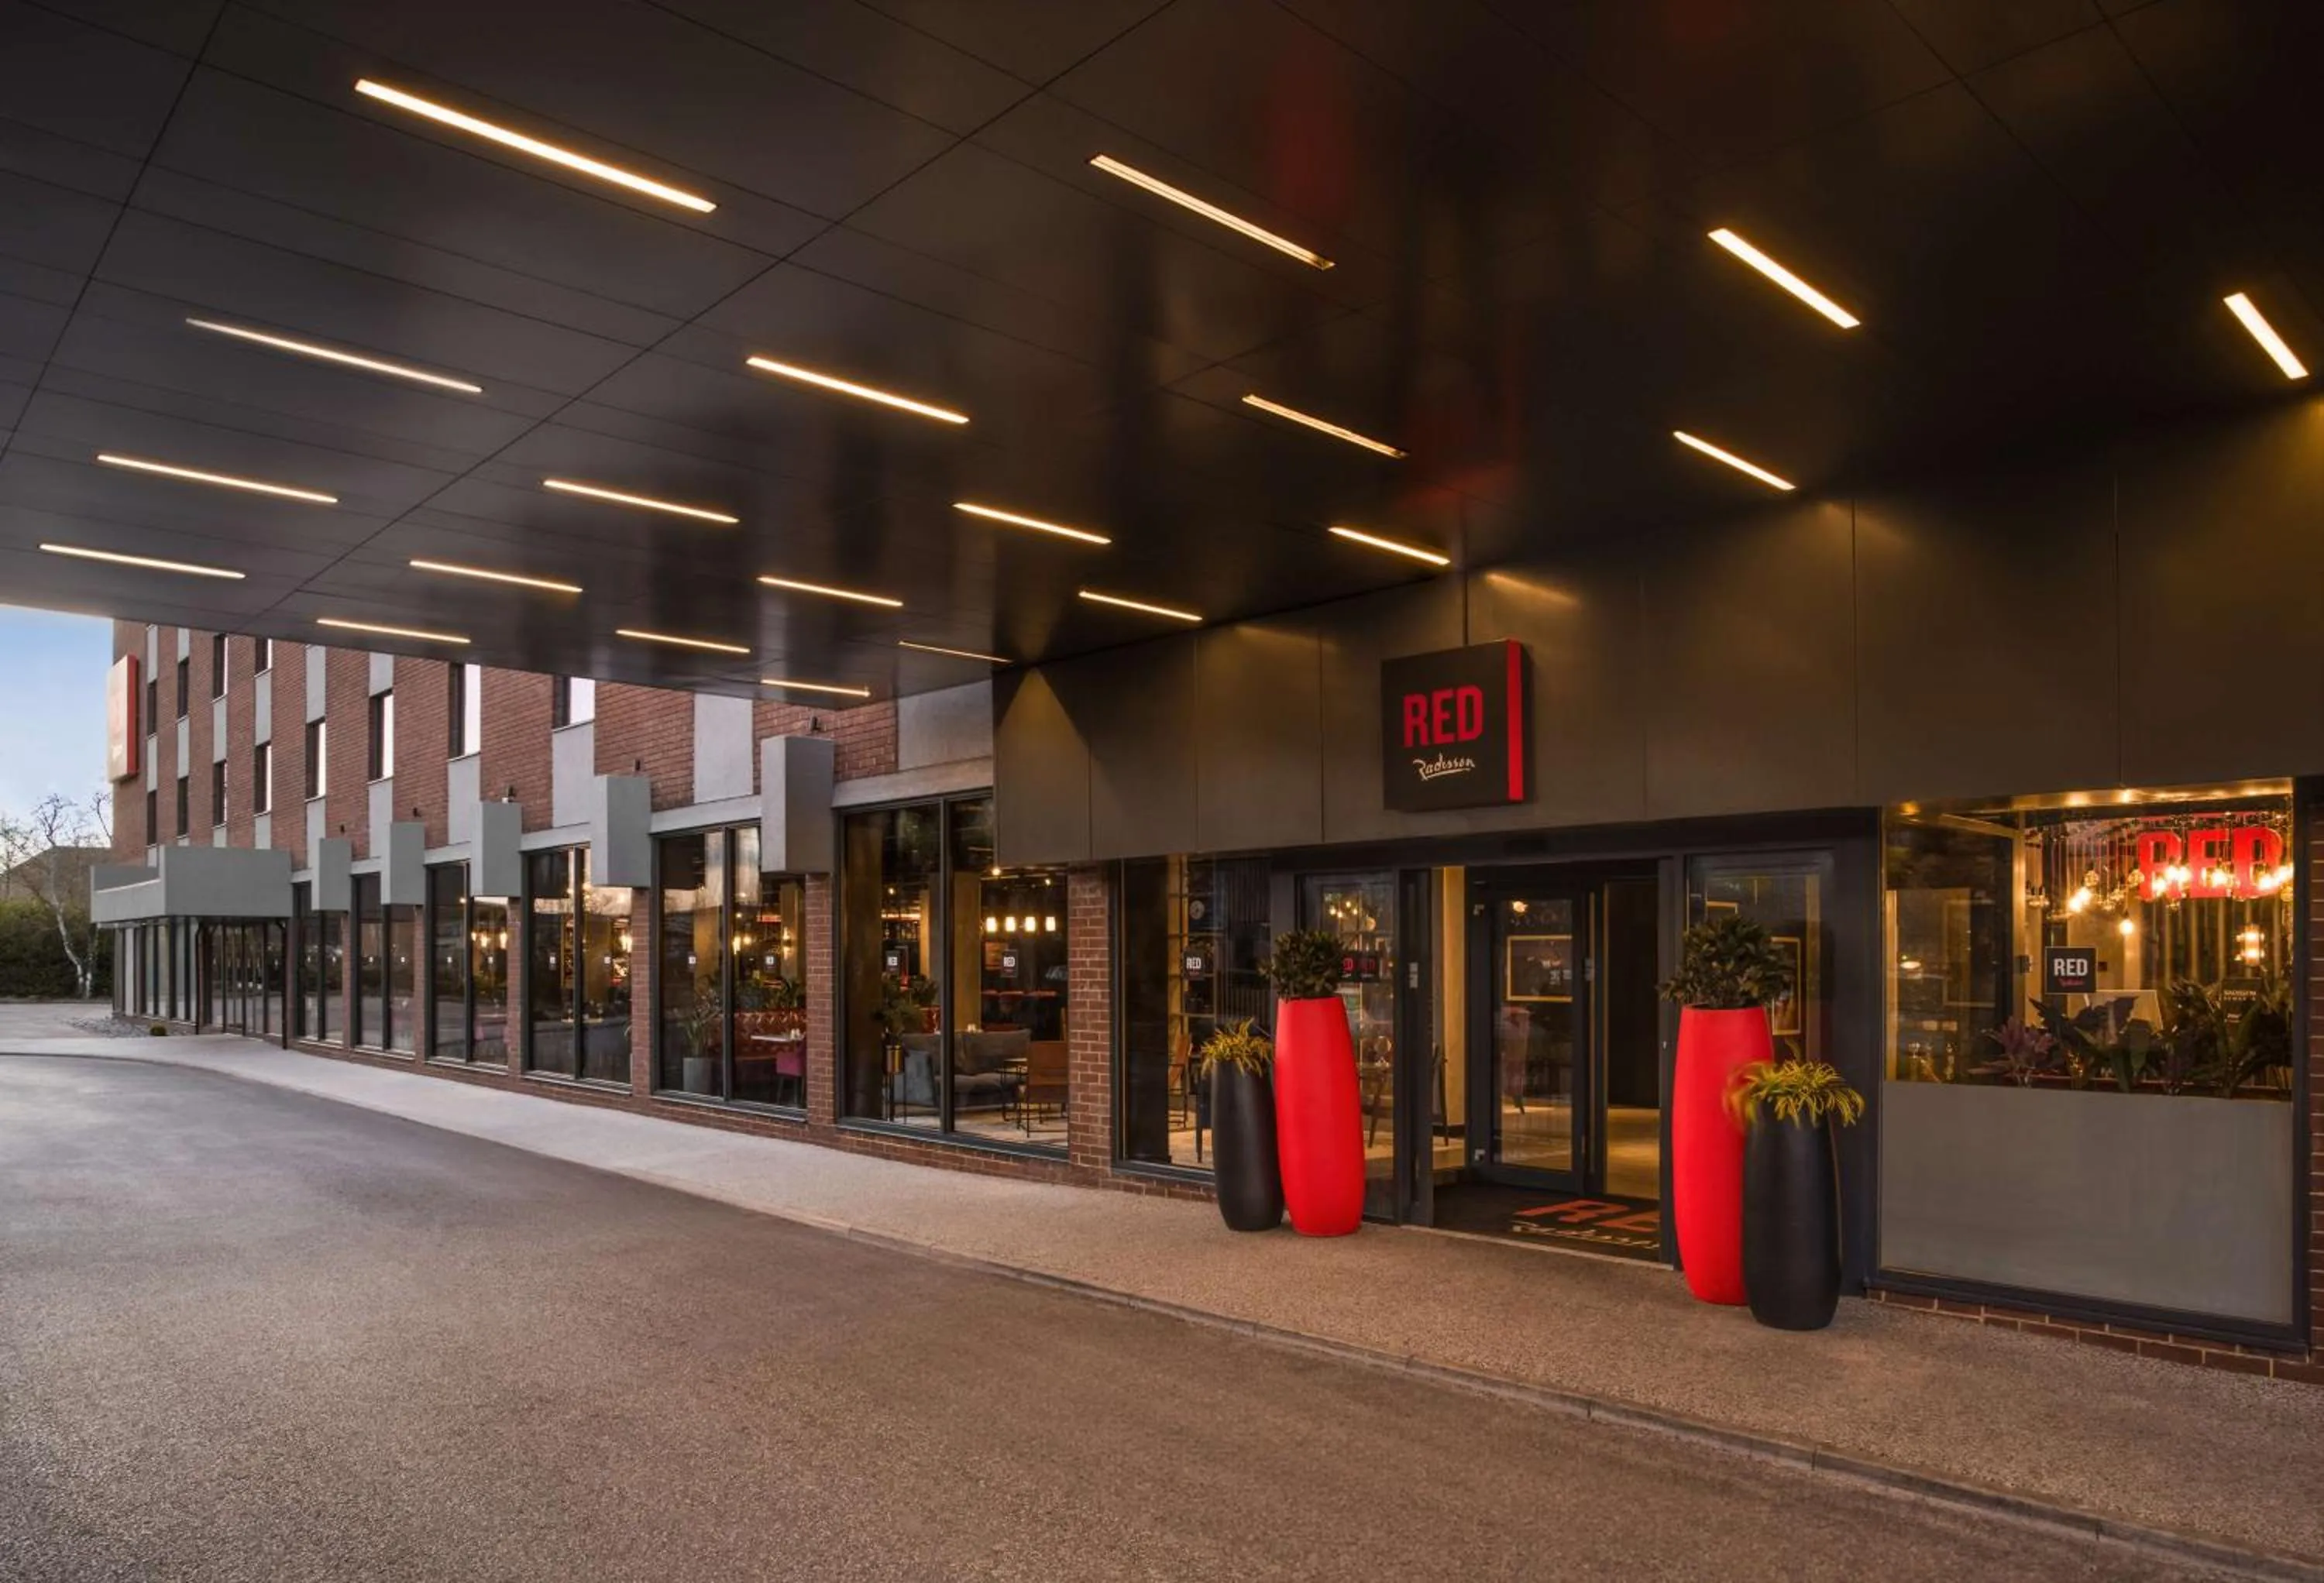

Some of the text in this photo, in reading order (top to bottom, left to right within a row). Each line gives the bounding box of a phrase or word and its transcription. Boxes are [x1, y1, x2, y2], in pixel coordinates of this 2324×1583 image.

[1403, 685, 1483, 747] RED
[1412, 752, 1475, 781] Radisson
[2137, 827, 2282, 901] RED
[2054, 958, 2089, 976] RED
[1513, 1200, 1660, 1232] RE
